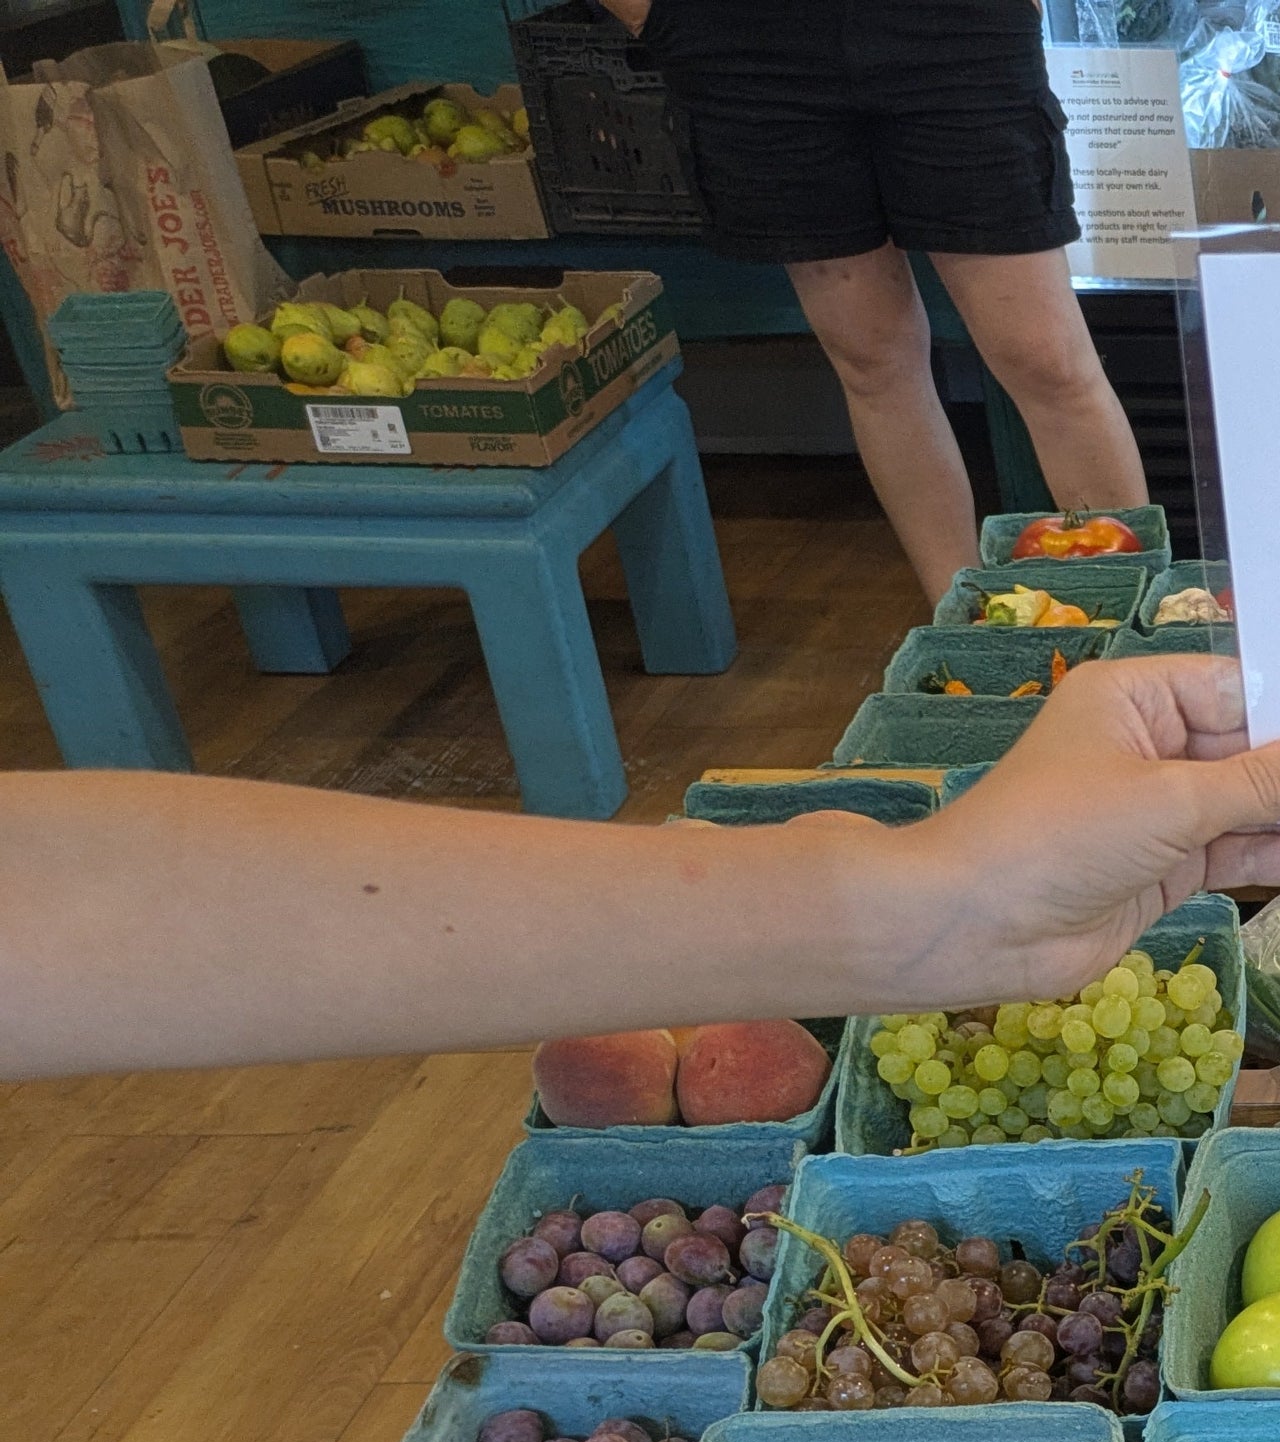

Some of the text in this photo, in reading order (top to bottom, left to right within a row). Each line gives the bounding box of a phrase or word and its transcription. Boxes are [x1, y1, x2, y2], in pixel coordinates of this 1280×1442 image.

[1067, 98, 1100, 107] requires
[1113, 98, 1122, 106] to
[1124, 97, 1149, 106] advise
[1092, 113, 1138, 122] pasteurized
[1139, 113, 1154, 121] and
[1156, 114, 1175, 123] may
[1104, 127, 1121, 135] that
[1147, 128, 1176, 136] human
[1073, 168, 1095, 177] these
[1148, 168, 1168, 178] dairy
[304, 175, 349, 199] FRESH
[1073, 182, 1095, 190] ducts
[1106, 183, 1124, 191] your
[321, 198, 467, 219] MUSHROOMS
[1088, 210, 1126, 218] questions
[1152, 209, 1185, 217] whether
[1086, 223, 1120, 231] products
[1136, 223, 1154, 232] right
[1157, 222, 1168, 231] for
[1086, 236, 1104, 244] with
[1106, 237, 1120, 245] any
[1121, 235, 1138, 243] staff
[146, 166, 216, 342] DER JOE'S
[588, 310, 658, 384] TOMATOES
[419, 404, 505, 419] TOMATES
